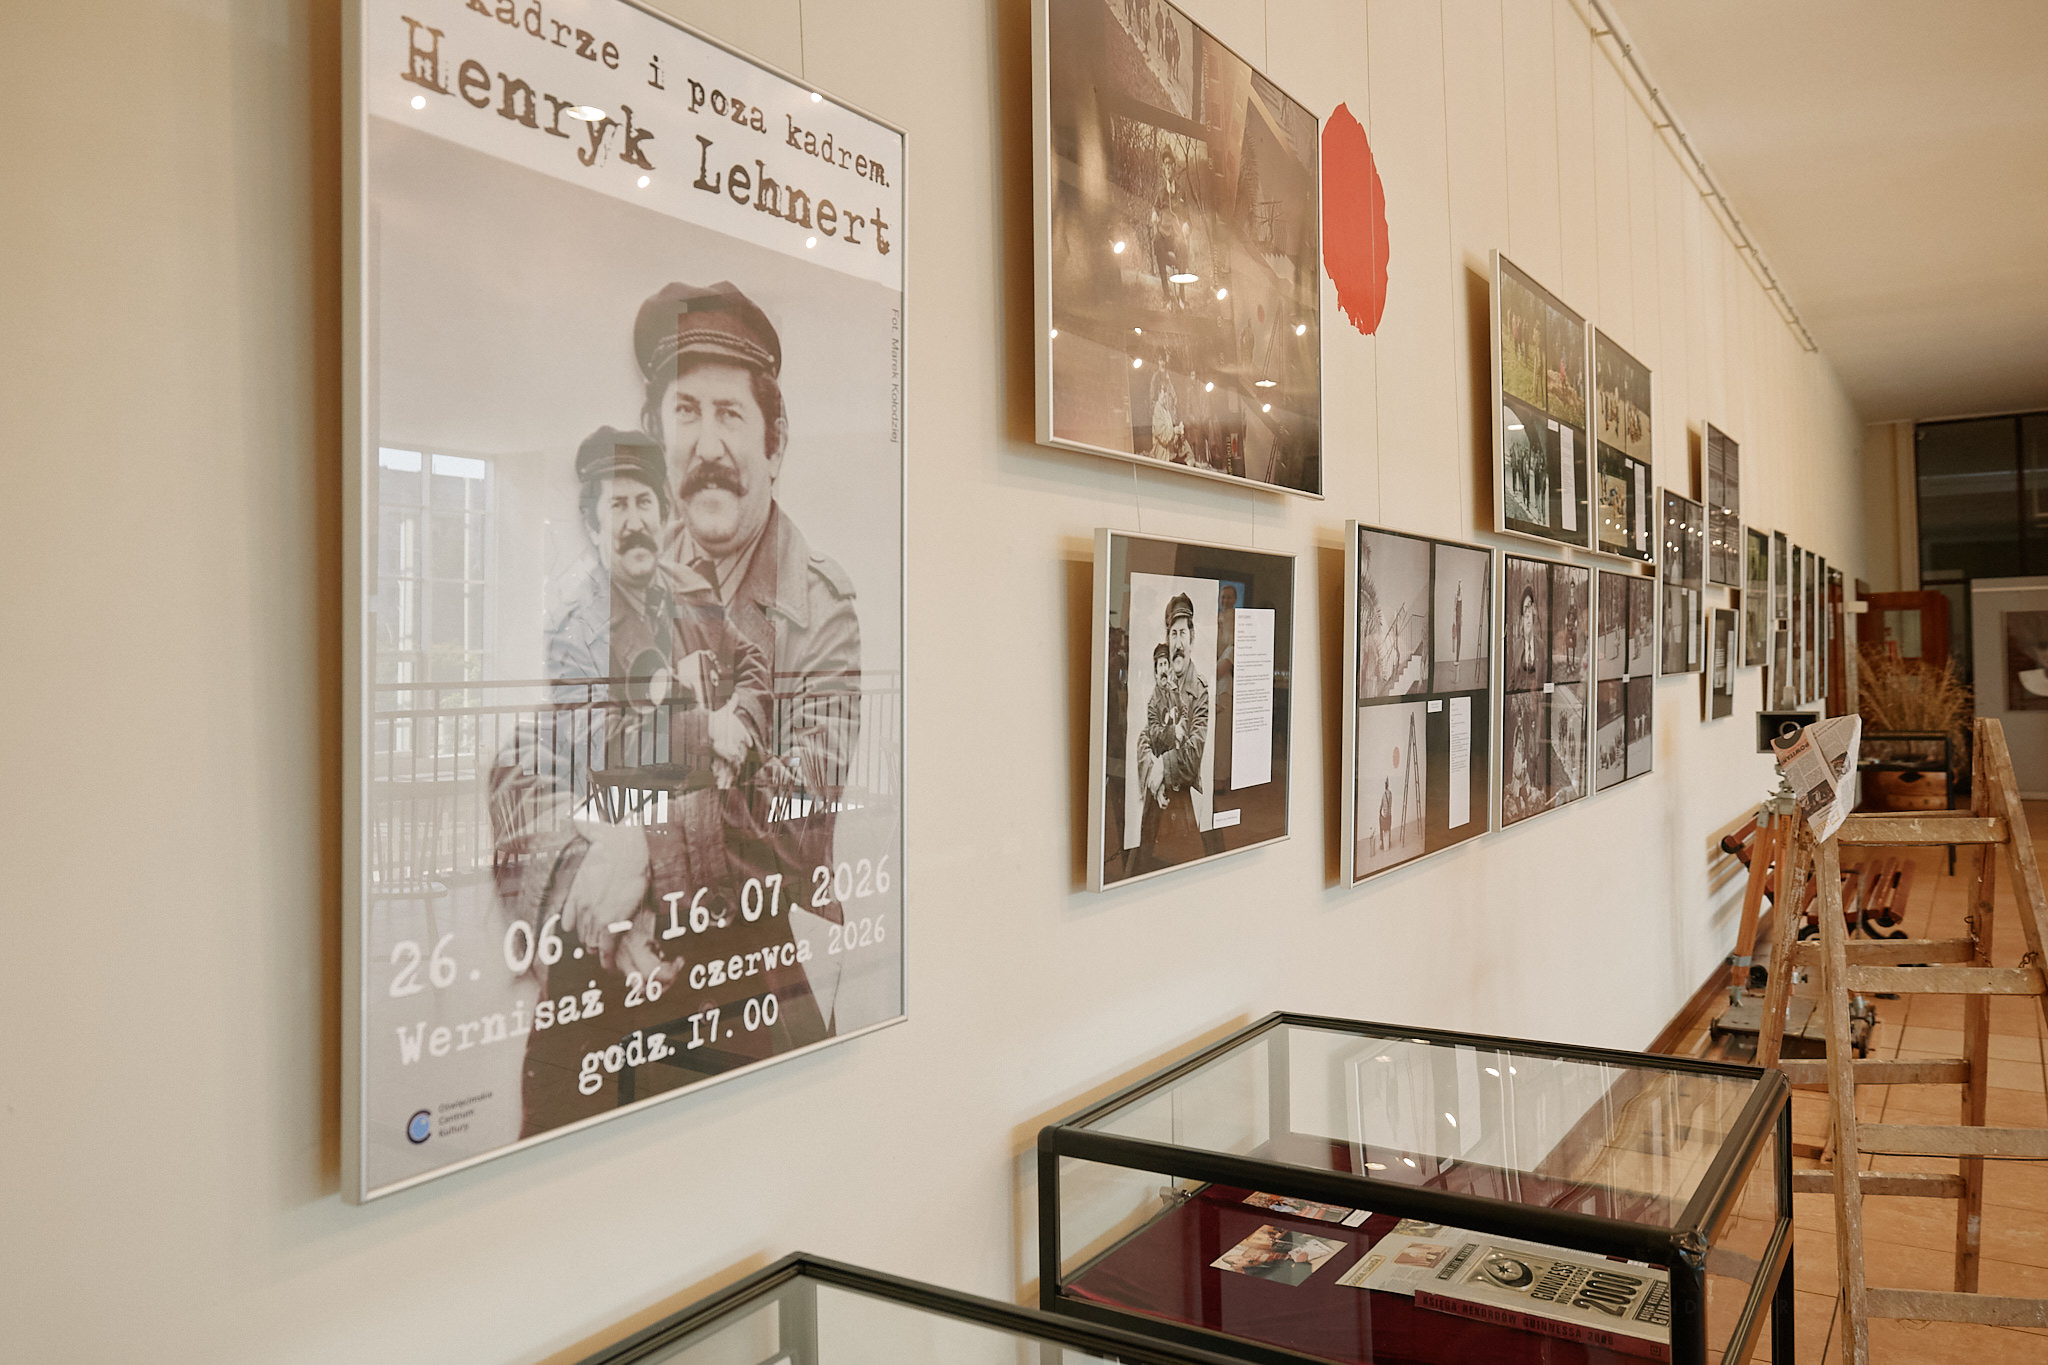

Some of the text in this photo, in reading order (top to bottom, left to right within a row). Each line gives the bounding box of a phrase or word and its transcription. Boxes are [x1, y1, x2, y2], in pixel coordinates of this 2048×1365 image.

[401, 15, 890, 255] Henryk Lehnert
[648, 55, 665, 90] i
[688, 78, 767, 134] poza
[786, 114, 890, 187] kadrem.
[891, 338, 900, 379] Marek
[396, 915, 886, 1066] Wernisaż 26 czerwca 2026
[578, 1029, 675, 1095] godz.
[1531, 1262, 1576, 1300] GUINNESS
[1573, 1271, 1642, 1317] 2000
[1587, 1331, 1614, 1346] 2000
